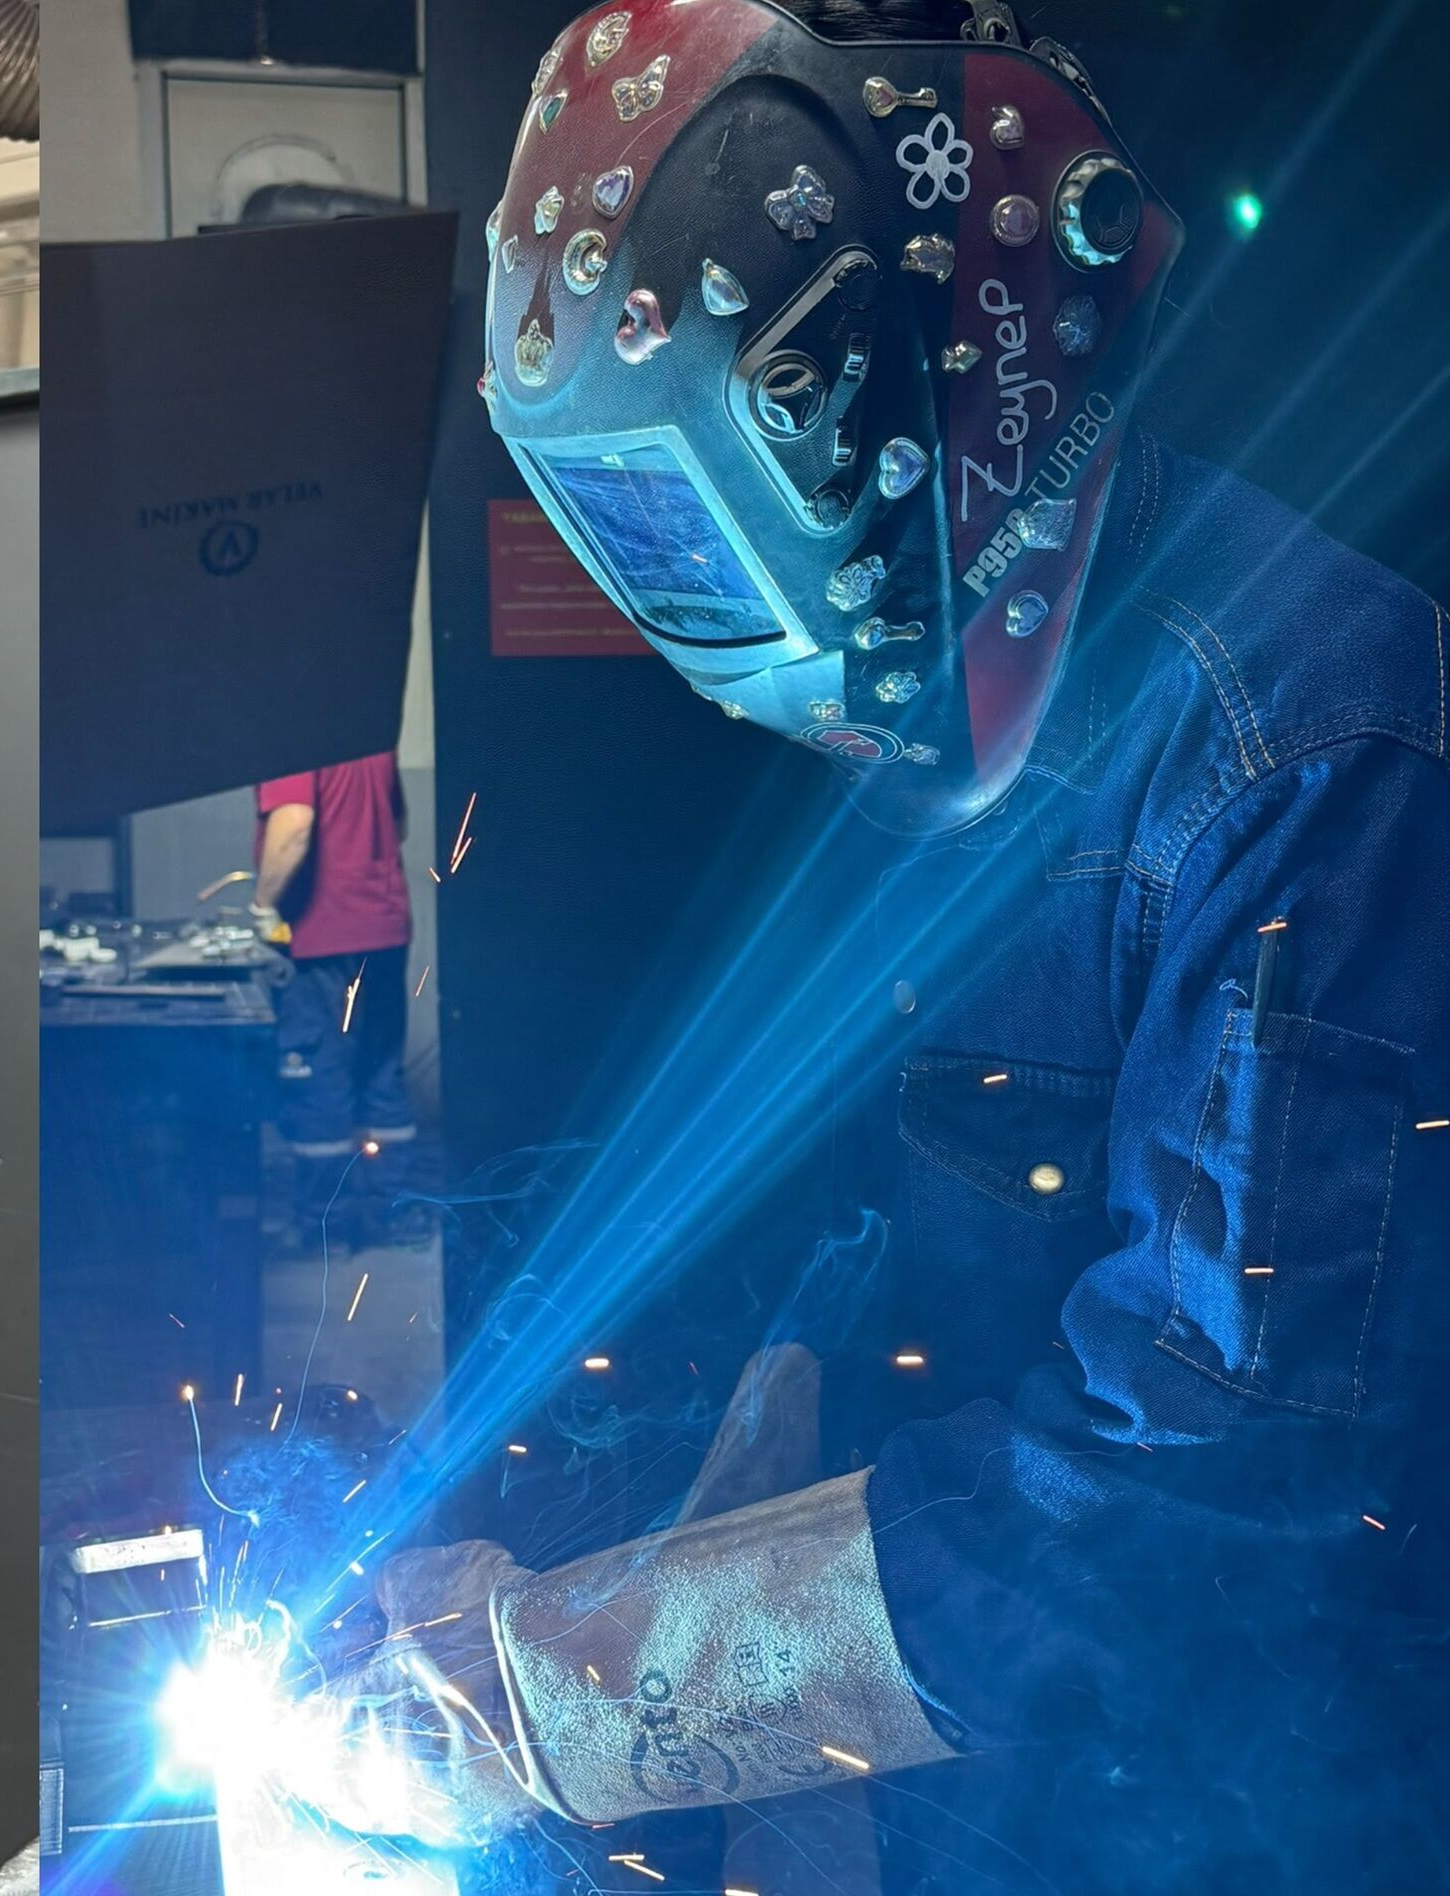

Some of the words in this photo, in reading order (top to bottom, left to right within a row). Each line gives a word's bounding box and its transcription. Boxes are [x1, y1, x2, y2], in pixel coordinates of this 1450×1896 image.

[961, 278, 1057, 522] Zeynep
[1024, 391, 1115, 500] TURBO
[247, 482, 323, 511] VELAR
